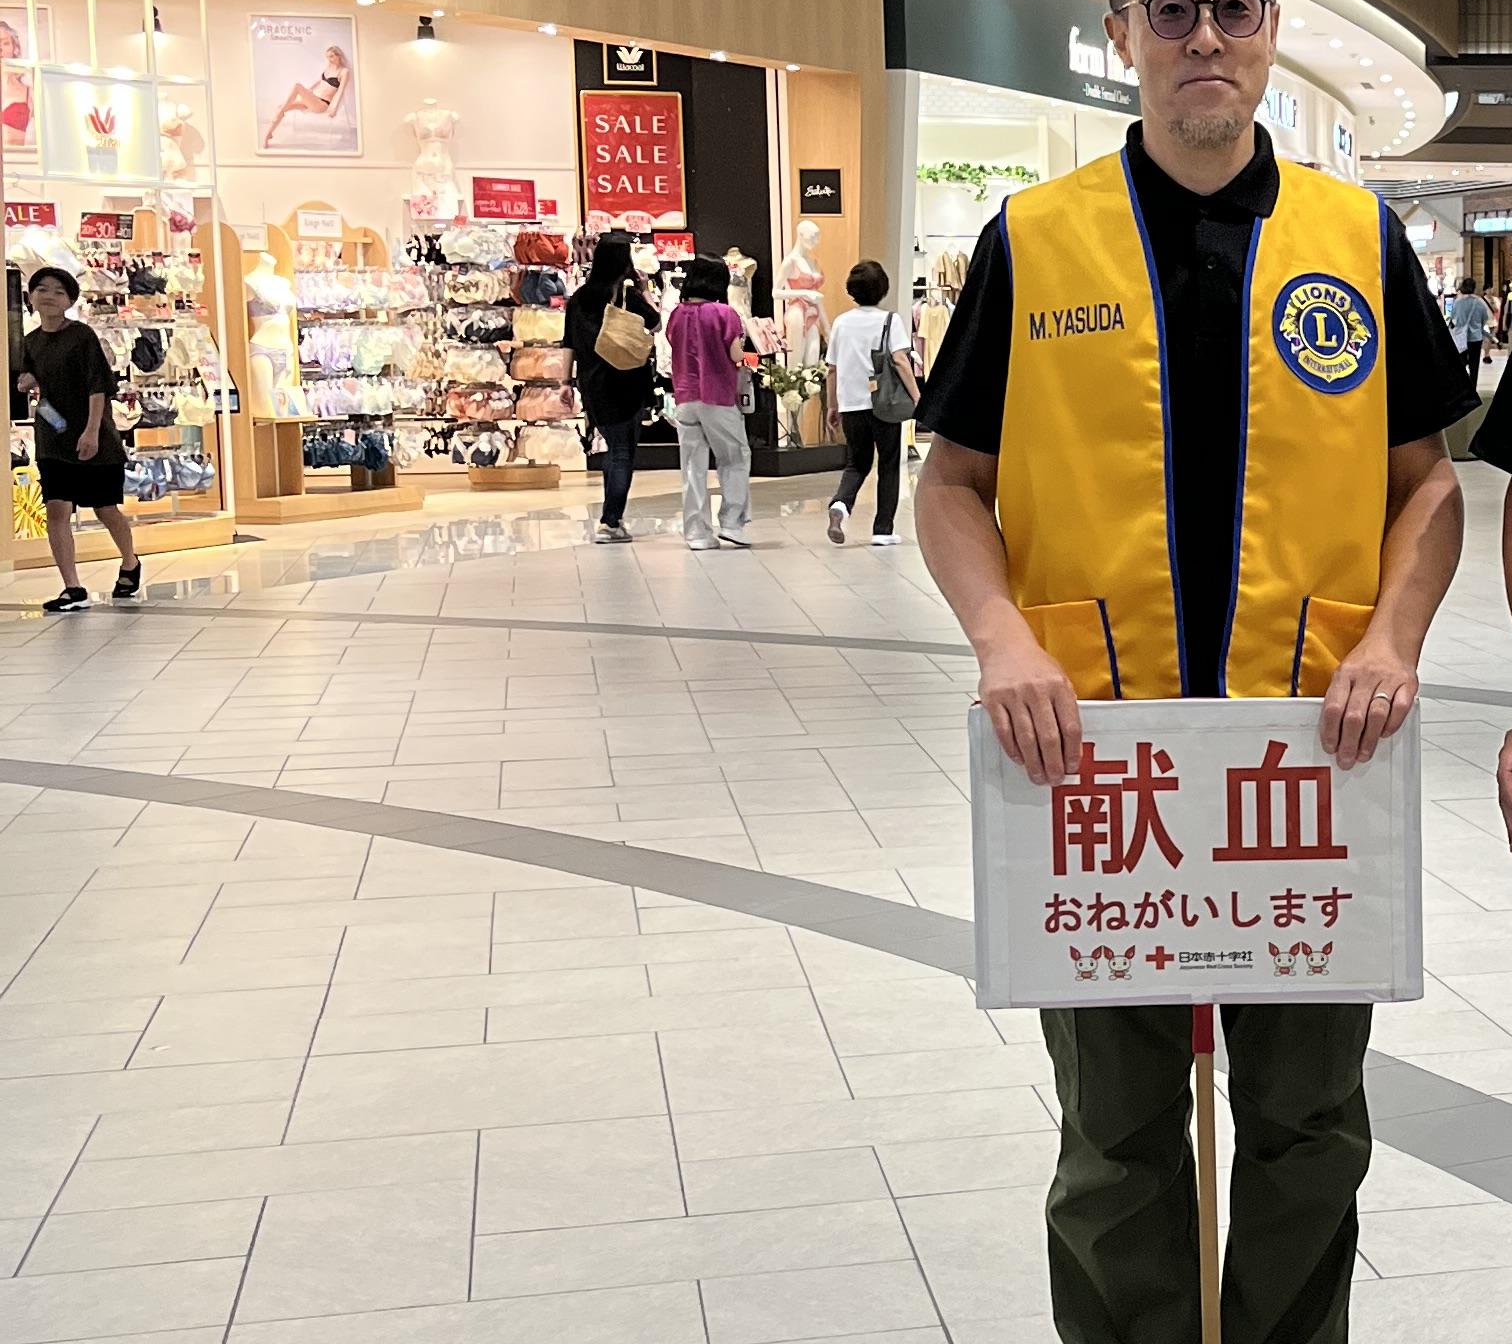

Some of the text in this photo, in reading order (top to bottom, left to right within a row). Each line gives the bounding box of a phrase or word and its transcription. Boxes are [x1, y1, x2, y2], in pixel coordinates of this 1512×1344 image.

[595, 114, 668, 134] SALE
[596, 144, 668, 164] SALE
[597, 174, 669, 194] SALE
[5, 205, 41, 222] ALE
[1294, 287, 1347, 308] LIONS
[1029, 302, 1125, 341] M.YASUDA
[1312, 312, 1338, 348] L
[1051, 740, 1348, 876] 献血
[1044, 886, 1353, 934] おねがいします
[1178, 951, 1254, 963] 日本赤十字社
